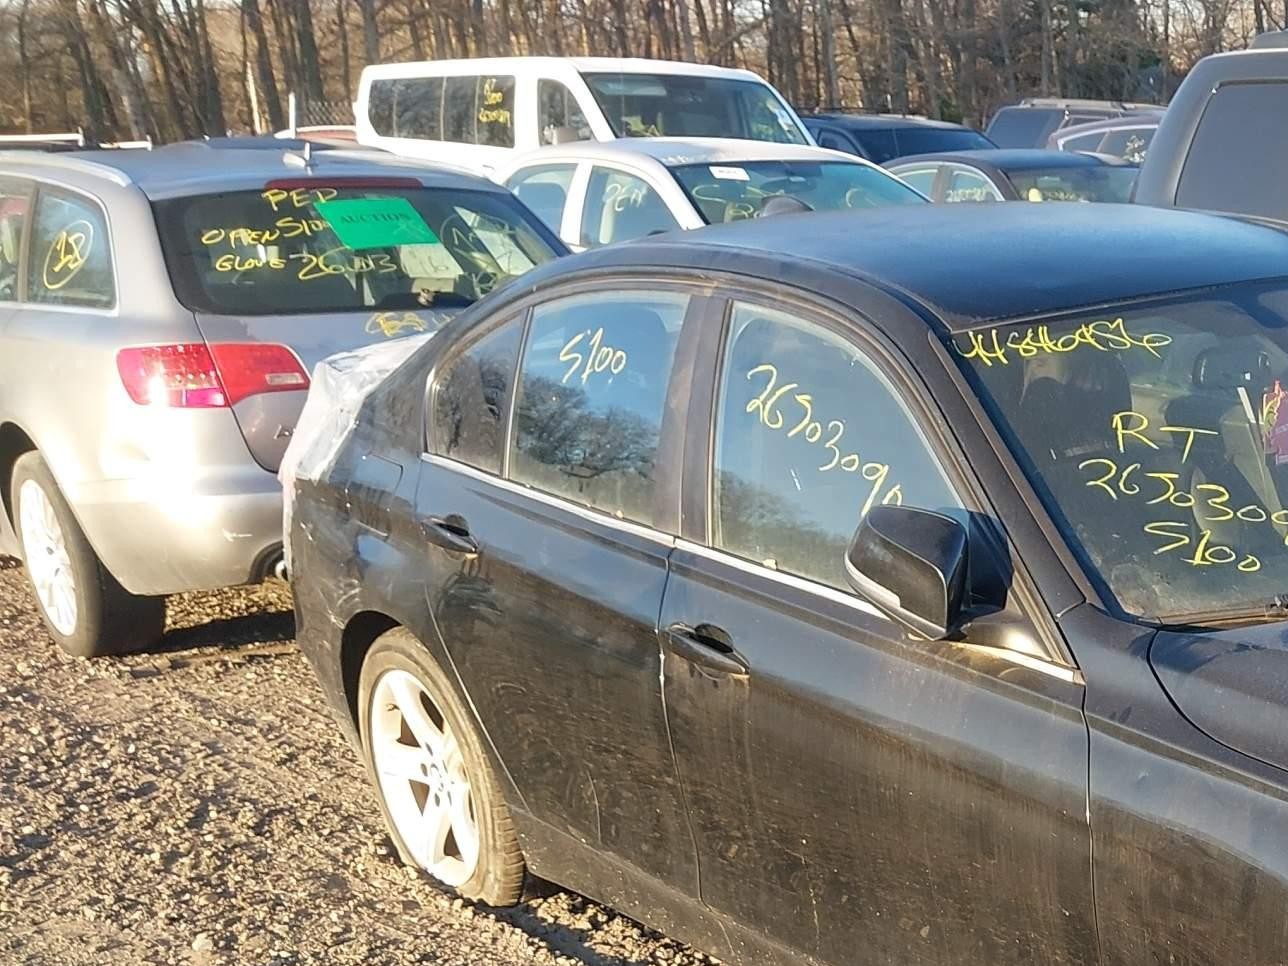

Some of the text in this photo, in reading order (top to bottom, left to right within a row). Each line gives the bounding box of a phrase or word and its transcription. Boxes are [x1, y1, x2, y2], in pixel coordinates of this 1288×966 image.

[261, 187, 338, 211] PED
[338, 212, 412, 224] AUCTION
[215, 253, 287, 272] GLOVE
[1143, 521, 1261, 572] S100
